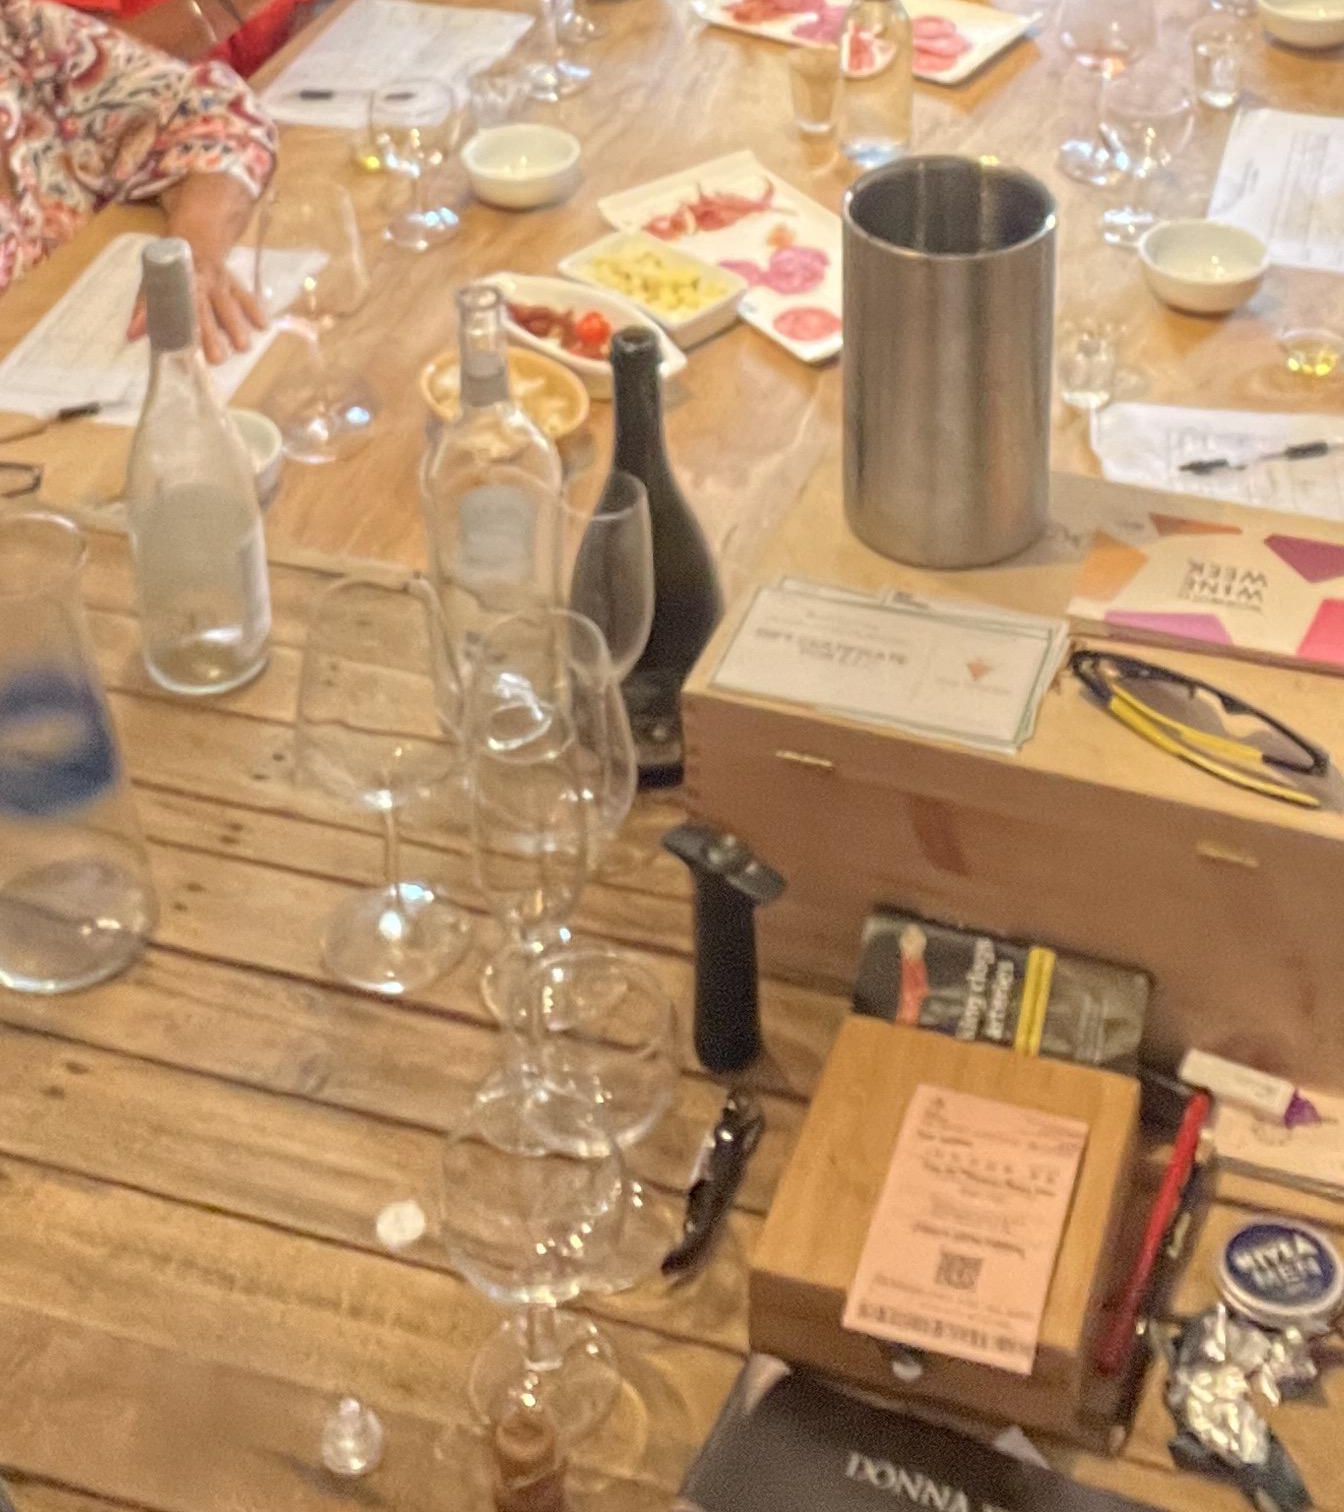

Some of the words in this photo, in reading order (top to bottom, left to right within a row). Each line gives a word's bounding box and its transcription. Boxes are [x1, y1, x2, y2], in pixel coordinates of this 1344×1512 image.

[1186, 556, 1269, 588] WEEK
[1183, 579, 1264, 604] WINE
[846, 1451, 969, 1512] DONNA
